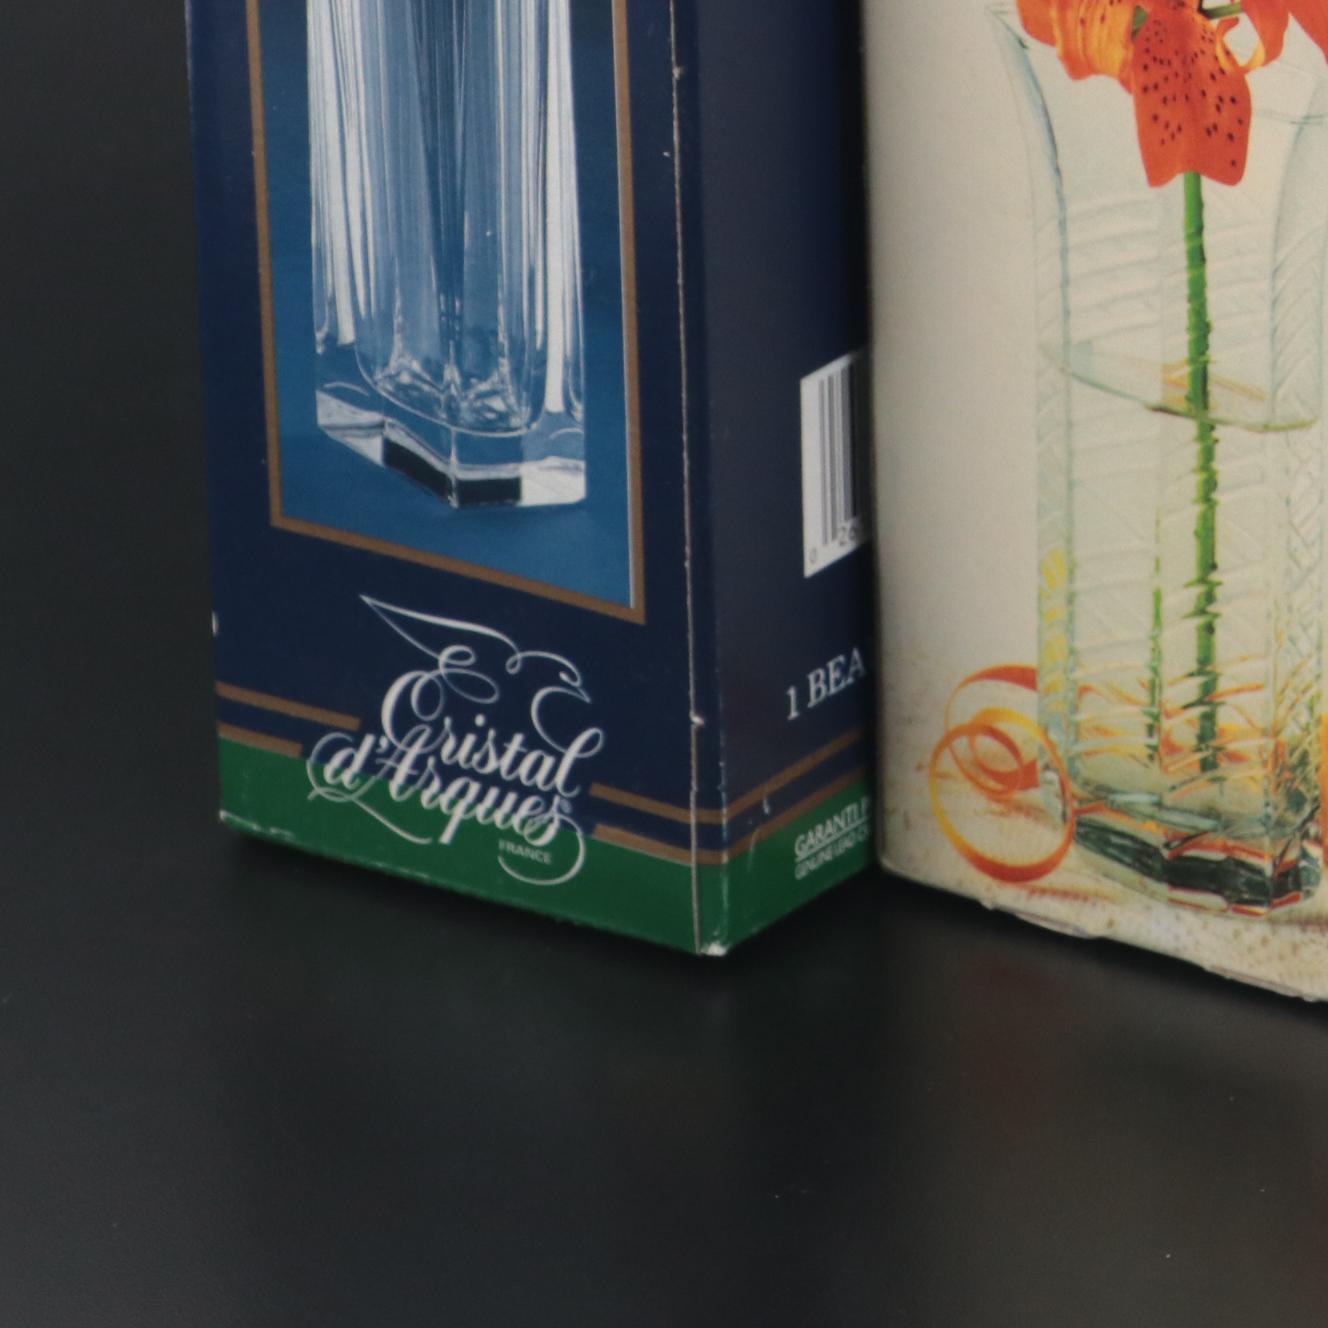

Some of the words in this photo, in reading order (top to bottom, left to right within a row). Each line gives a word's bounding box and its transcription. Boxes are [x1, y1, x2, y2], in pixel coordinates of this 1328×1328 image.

[380, 662, 604, 798] Cristal
[785, 685, 801, 722] 1
[306, 725, 586, 852] d'Arques
[499, 838, 553, 866] FRANCE
